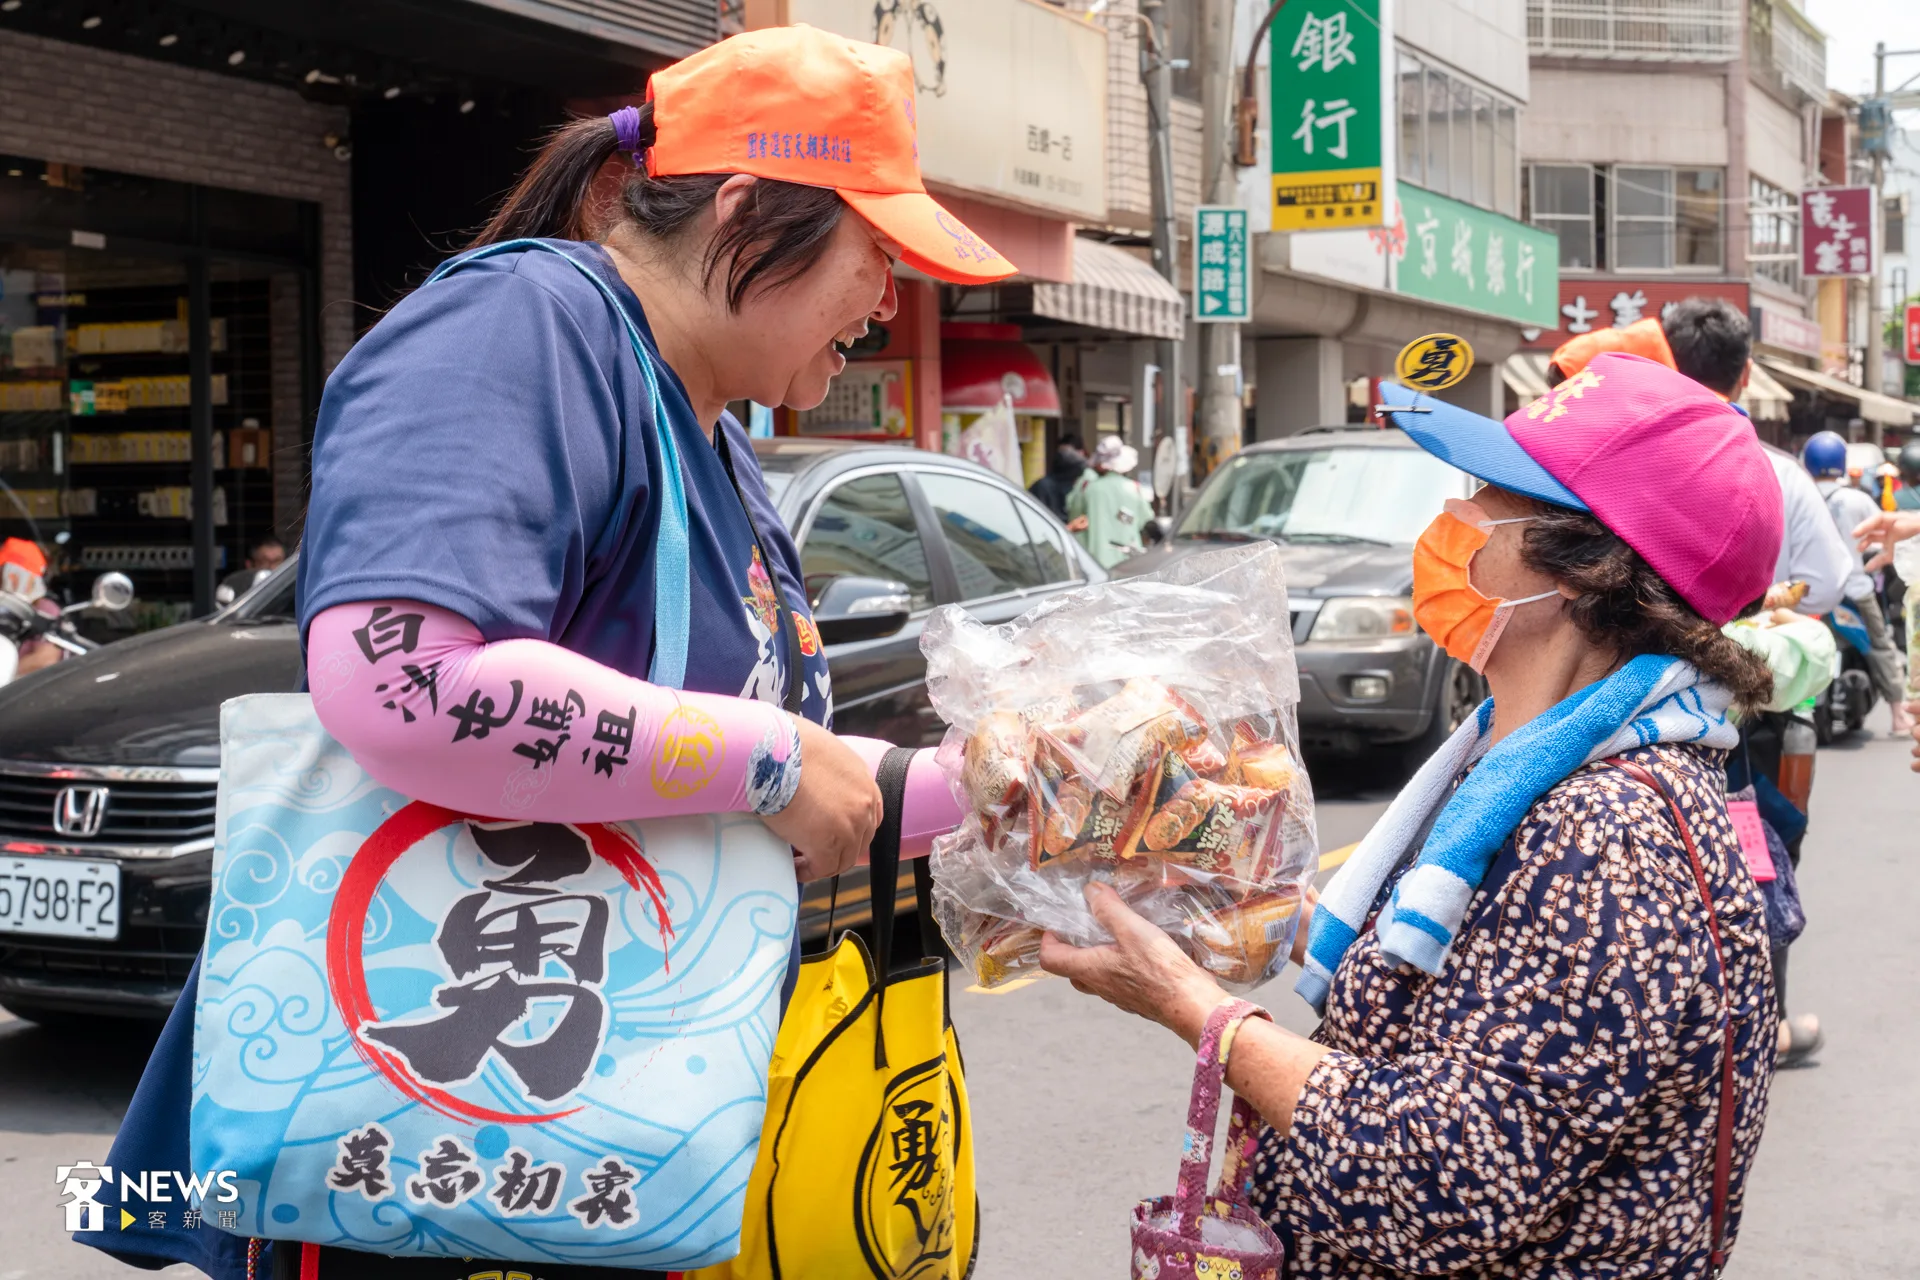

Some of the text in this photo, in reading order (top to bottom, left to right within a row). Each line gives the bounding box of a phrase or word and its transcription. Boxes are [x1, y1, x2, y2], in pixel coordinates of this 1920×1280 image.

[1290, 11, 1358, 160] 銀行
[1416, 206, 1536, 306] 京城銀行
[1402, 338, 1459, 386] 勇
[352, 606, 638, 779] 白沙屯媽祖
[362, 821, 610, 1101] 勇
[330, 1127, 637, 1225] 莫忘初衷
